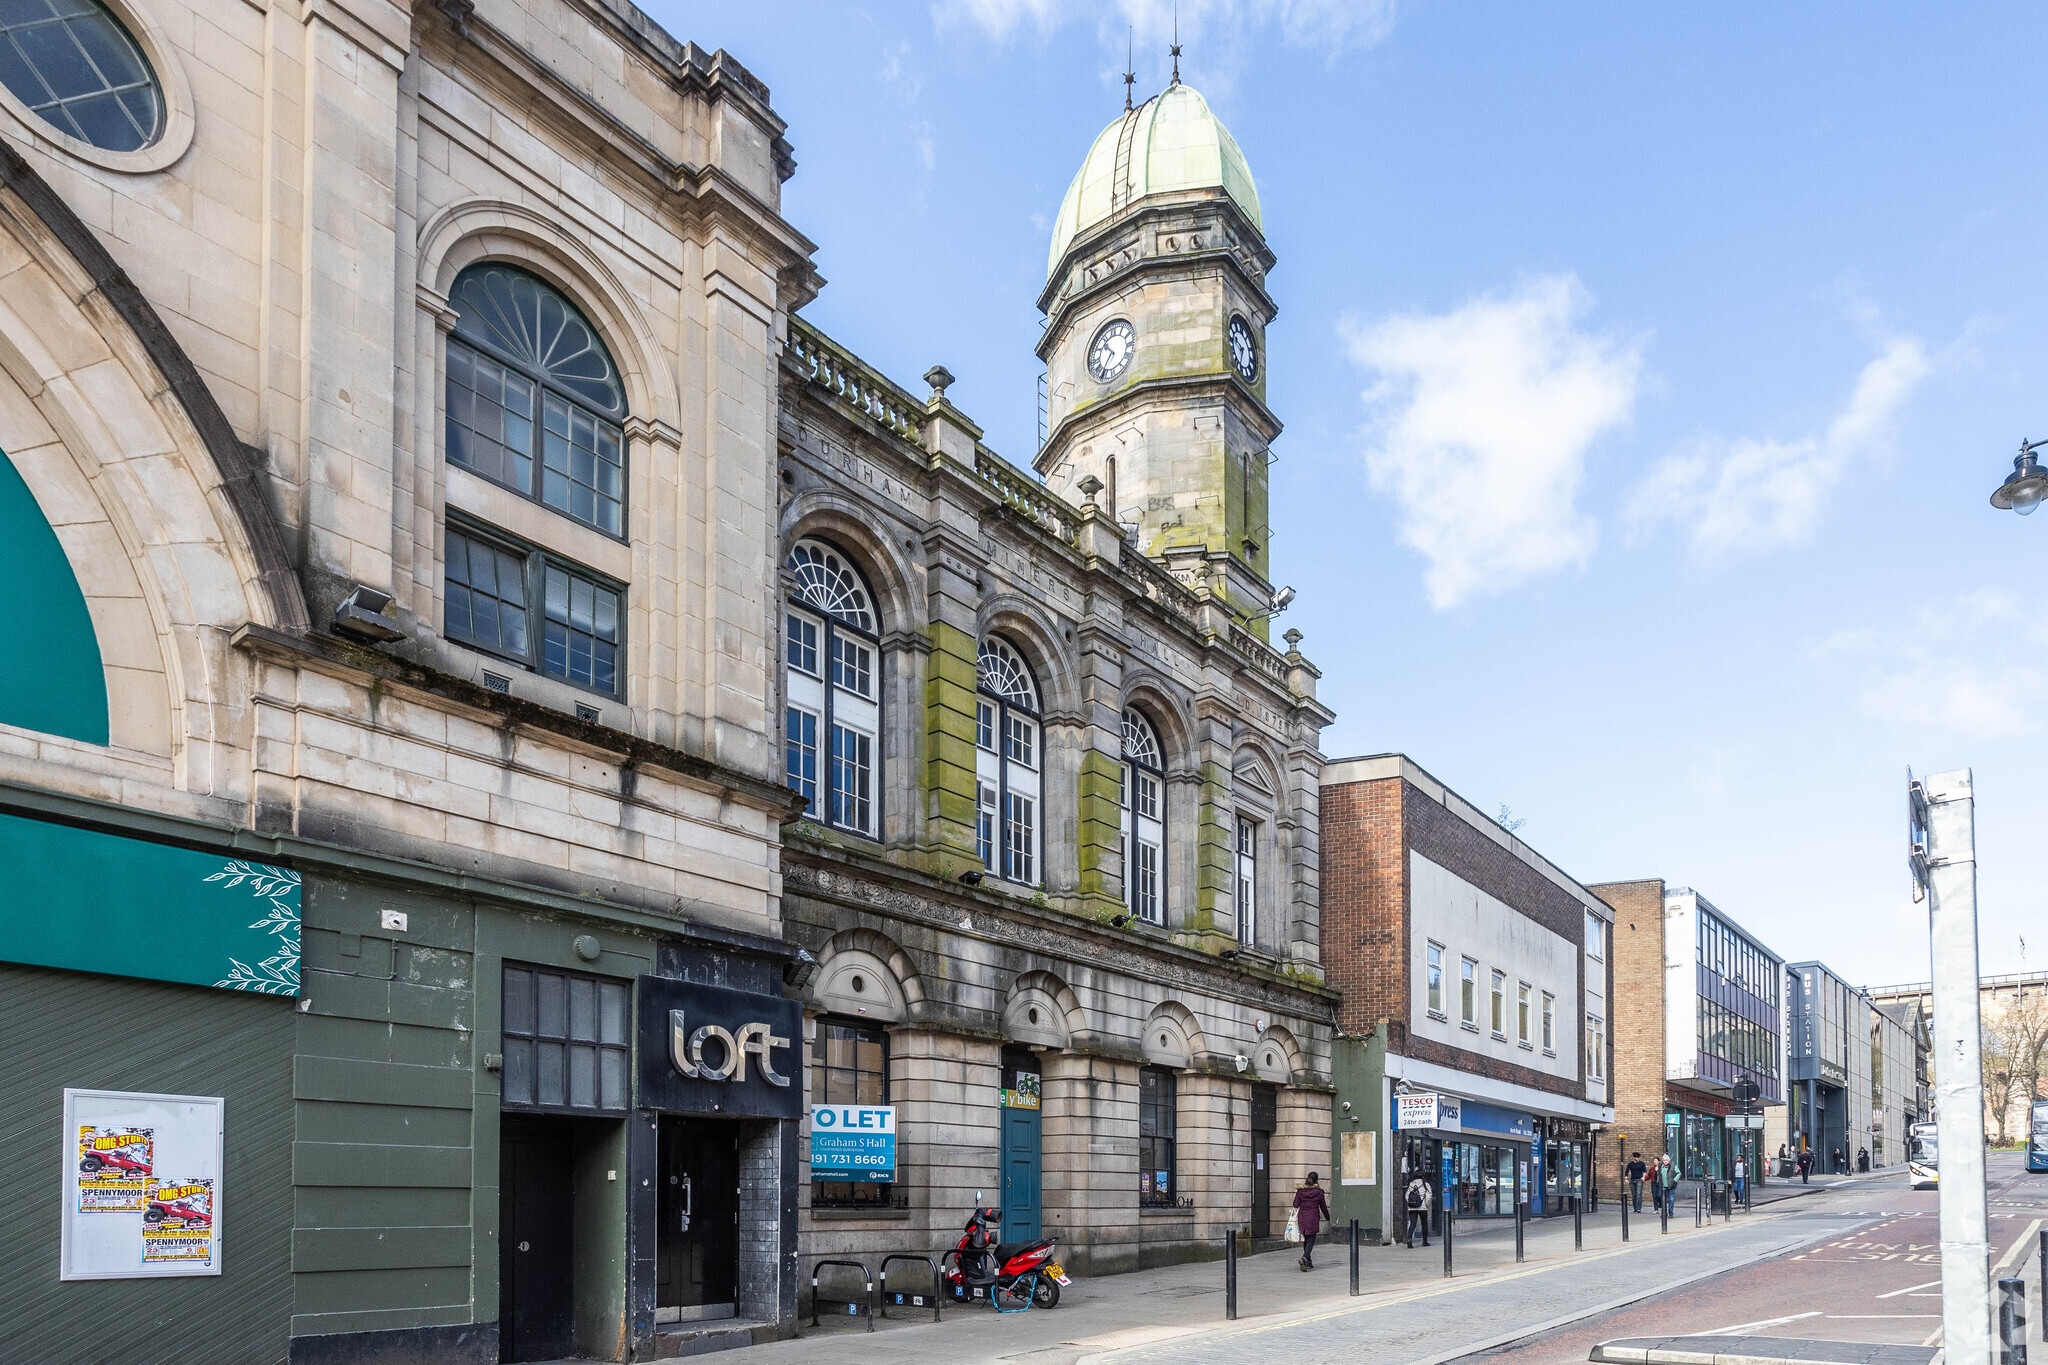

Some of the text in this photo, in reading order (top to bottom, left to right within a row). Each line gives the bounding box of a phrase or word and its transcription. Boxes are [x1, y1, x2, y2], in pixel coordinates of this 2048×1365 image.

[798, 426, 911, 505] DURHAM
[987, 541, 1070, 601] MINERS
[1140, 634, 1179, 667] HALL
[1804, 1003, 1812, 1055] STATION
[1402, 1098, 1433, 1106] TESCO
[843, 1109, 891, 1128] LET
[1403, 1109, 1432, 1118] express
[95, 1135, 147, 1150] OMG STUNTS
[820, 1137, 886, 1148] Graham S Hall
[832, 1154, 850, 1163] 731
[854, 1155, 886, 1165] 8660
[159, 1185, 207, 1201] OMG STUNTS
[145, 1238, 203, 1246] SPENNYMOOR
